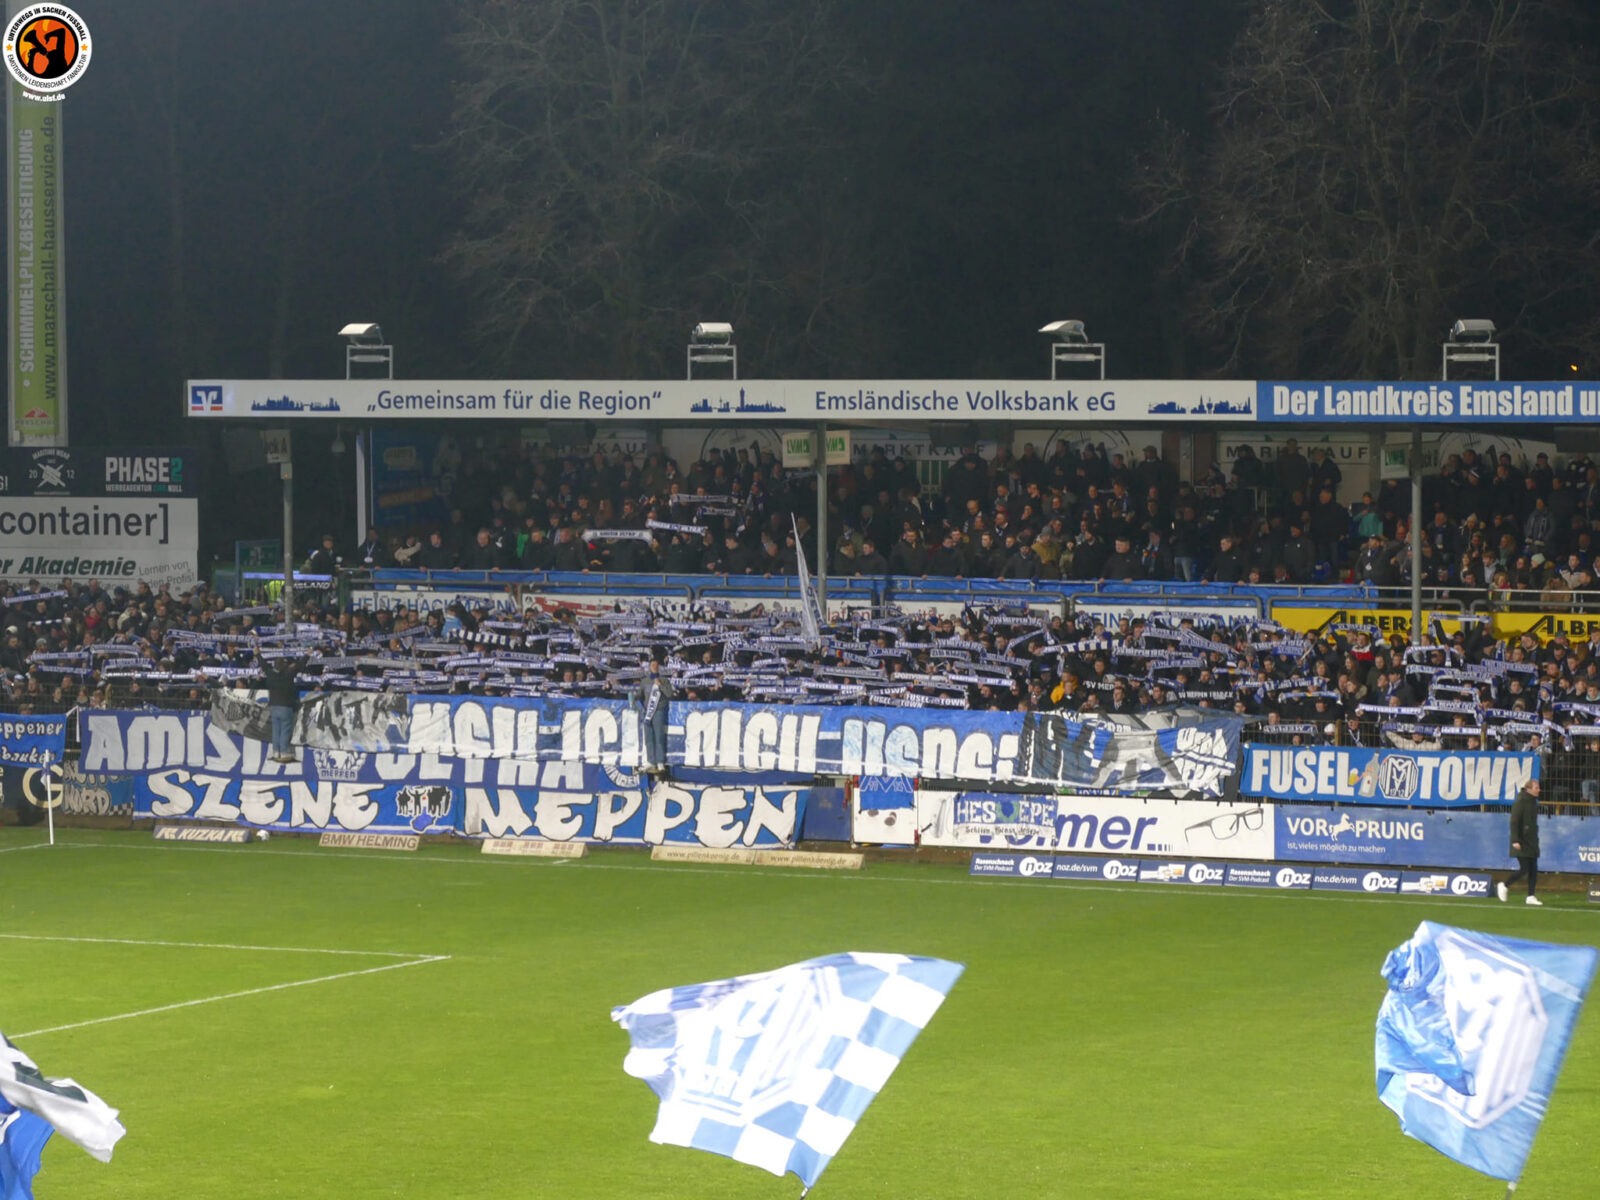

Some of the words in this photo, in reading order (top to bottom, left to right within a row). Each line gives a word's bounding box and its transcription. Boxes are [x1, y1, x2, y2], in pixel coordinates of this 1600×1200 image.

[18, 128, 35, 373] SCHIMMELPILZBESEITIGUNG
[41, 116, 56, 400] www.marschall-hausservice.de
[503, 389, 533, 410] für
[540, 387, 572, 411] die
[815, 389, 959, 411] Emsländische
[966, 390, 1079, 412] Volksbank
[1086, 391, 1115, 411] eG
[1273, 386, 1319, 416] Der
[1324, 385, 1453, 417] Landkreis
[1459, 385, 1573, 418] Emsland
[29, 470, 38, 479] 20
[66, 470, 75, 480] 12
[18, 556, 136, 576] Akademie
[172, 560, 189, 571] von
[901, 700, 923, 708] TOWN
[906, 693, 930, 704] FUSEL
[940, 697, 966, 707] TOWN
[1251, 749, 1356, 797] FUSEL
[1418, 756, 1537, 801] TOWN
[147, 769, 384, 832] SZENE
[463, 782, 797, 849] MEPPEN
[179, 829, 226, 840] KUZKA
[320, 833, 353, 845] BMW
[357, 834, 417, 849] HELMING
[1298, 842, 1318, 850] vieles
[1320, 843, 1347, 853] möglich
[1358, 845, 1386, 853] machen
[1024, 859, 1053, 875] noz
[1056, 863, 1098, 873] noz.de/svm
[1106, 862, 1137, 878] noz
[1191, 866, 1223, 881] noz
[1279, 870, 1311, 886] noz
[1315, 874, 1357, 885] noz.de/svm
[1366, 874, 1398, 889] noz
[1454, 877, 1488, 893] noz
